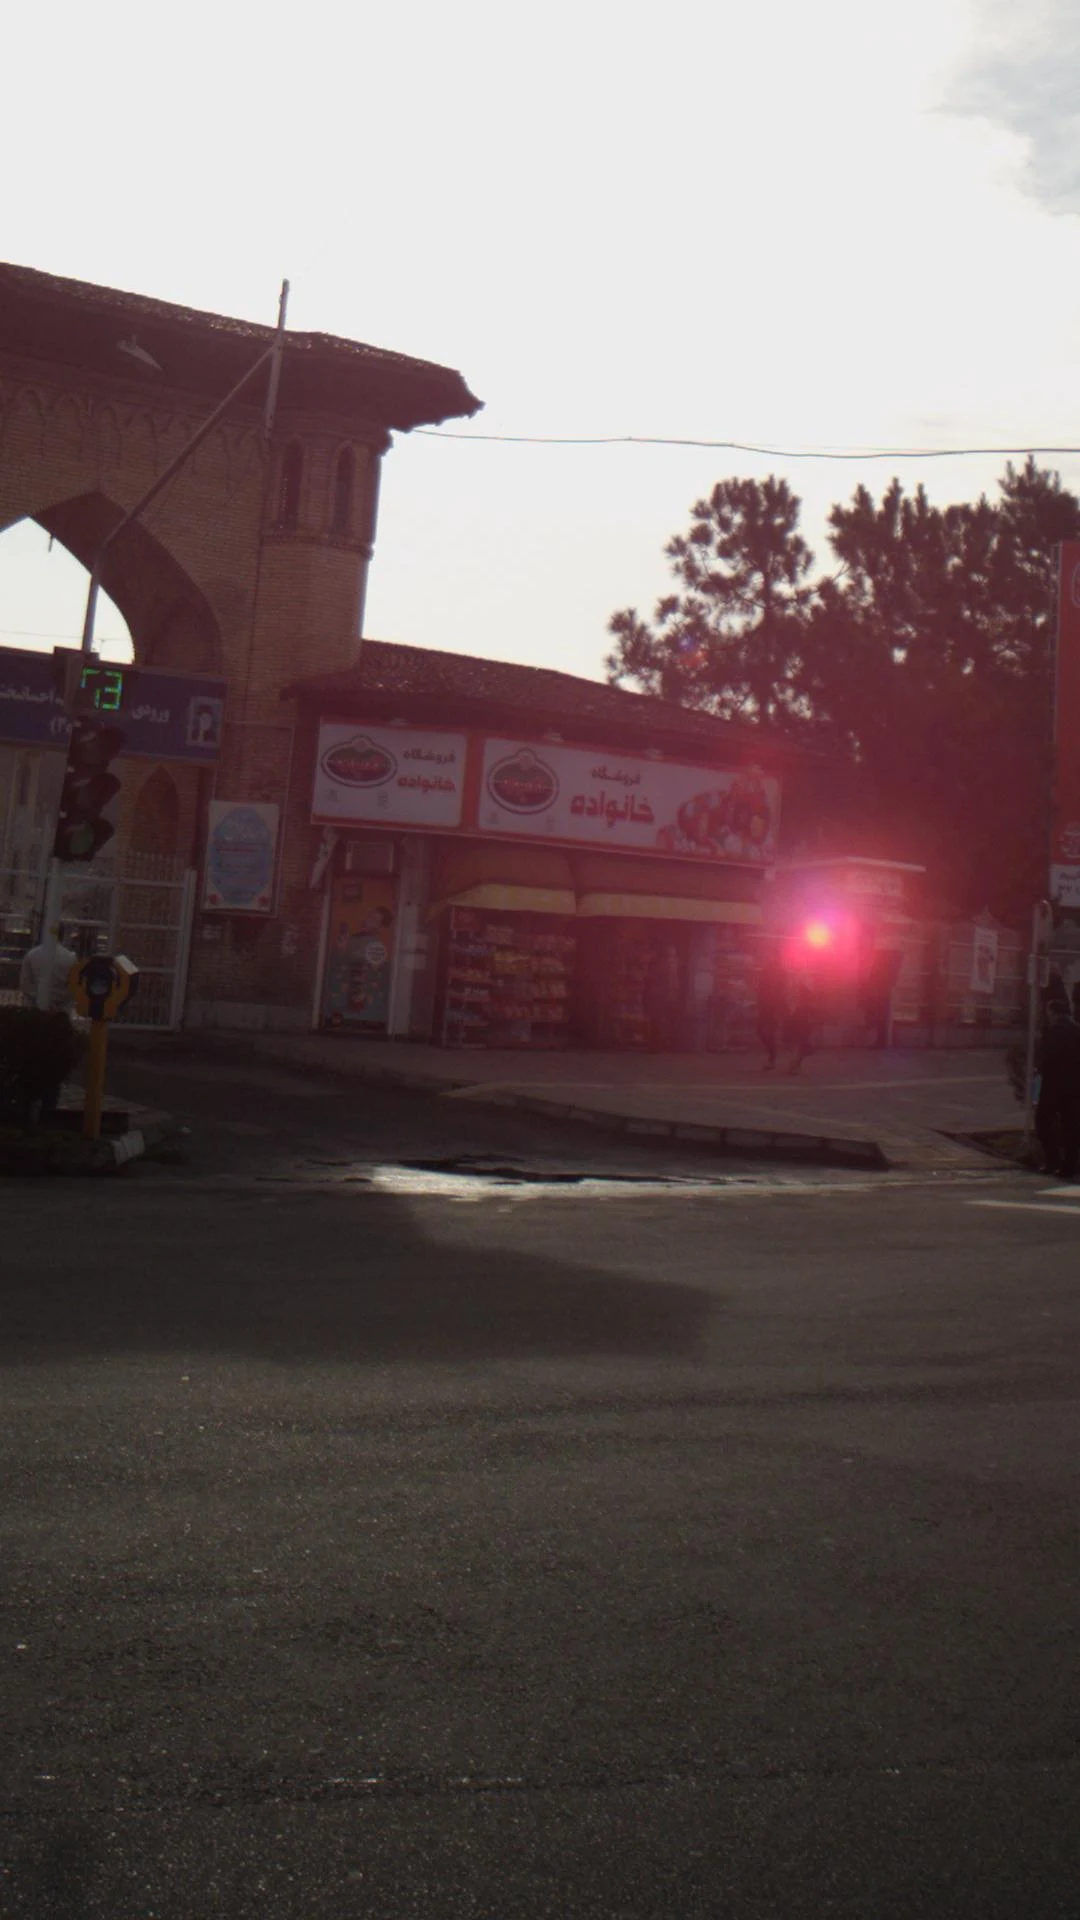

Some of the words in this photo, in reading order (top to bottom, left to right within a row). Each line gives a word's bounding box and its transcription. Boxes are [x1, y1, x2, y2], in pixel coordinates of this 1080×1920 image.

[131, 704, 172, 724] ورودی
[403, 748, 456, 765] فروشگاه
[398, 775, 456, 795] خانواده
[591, 765, 641, 787] فروشگاه
[570, 791, 654, 828] خانواده
